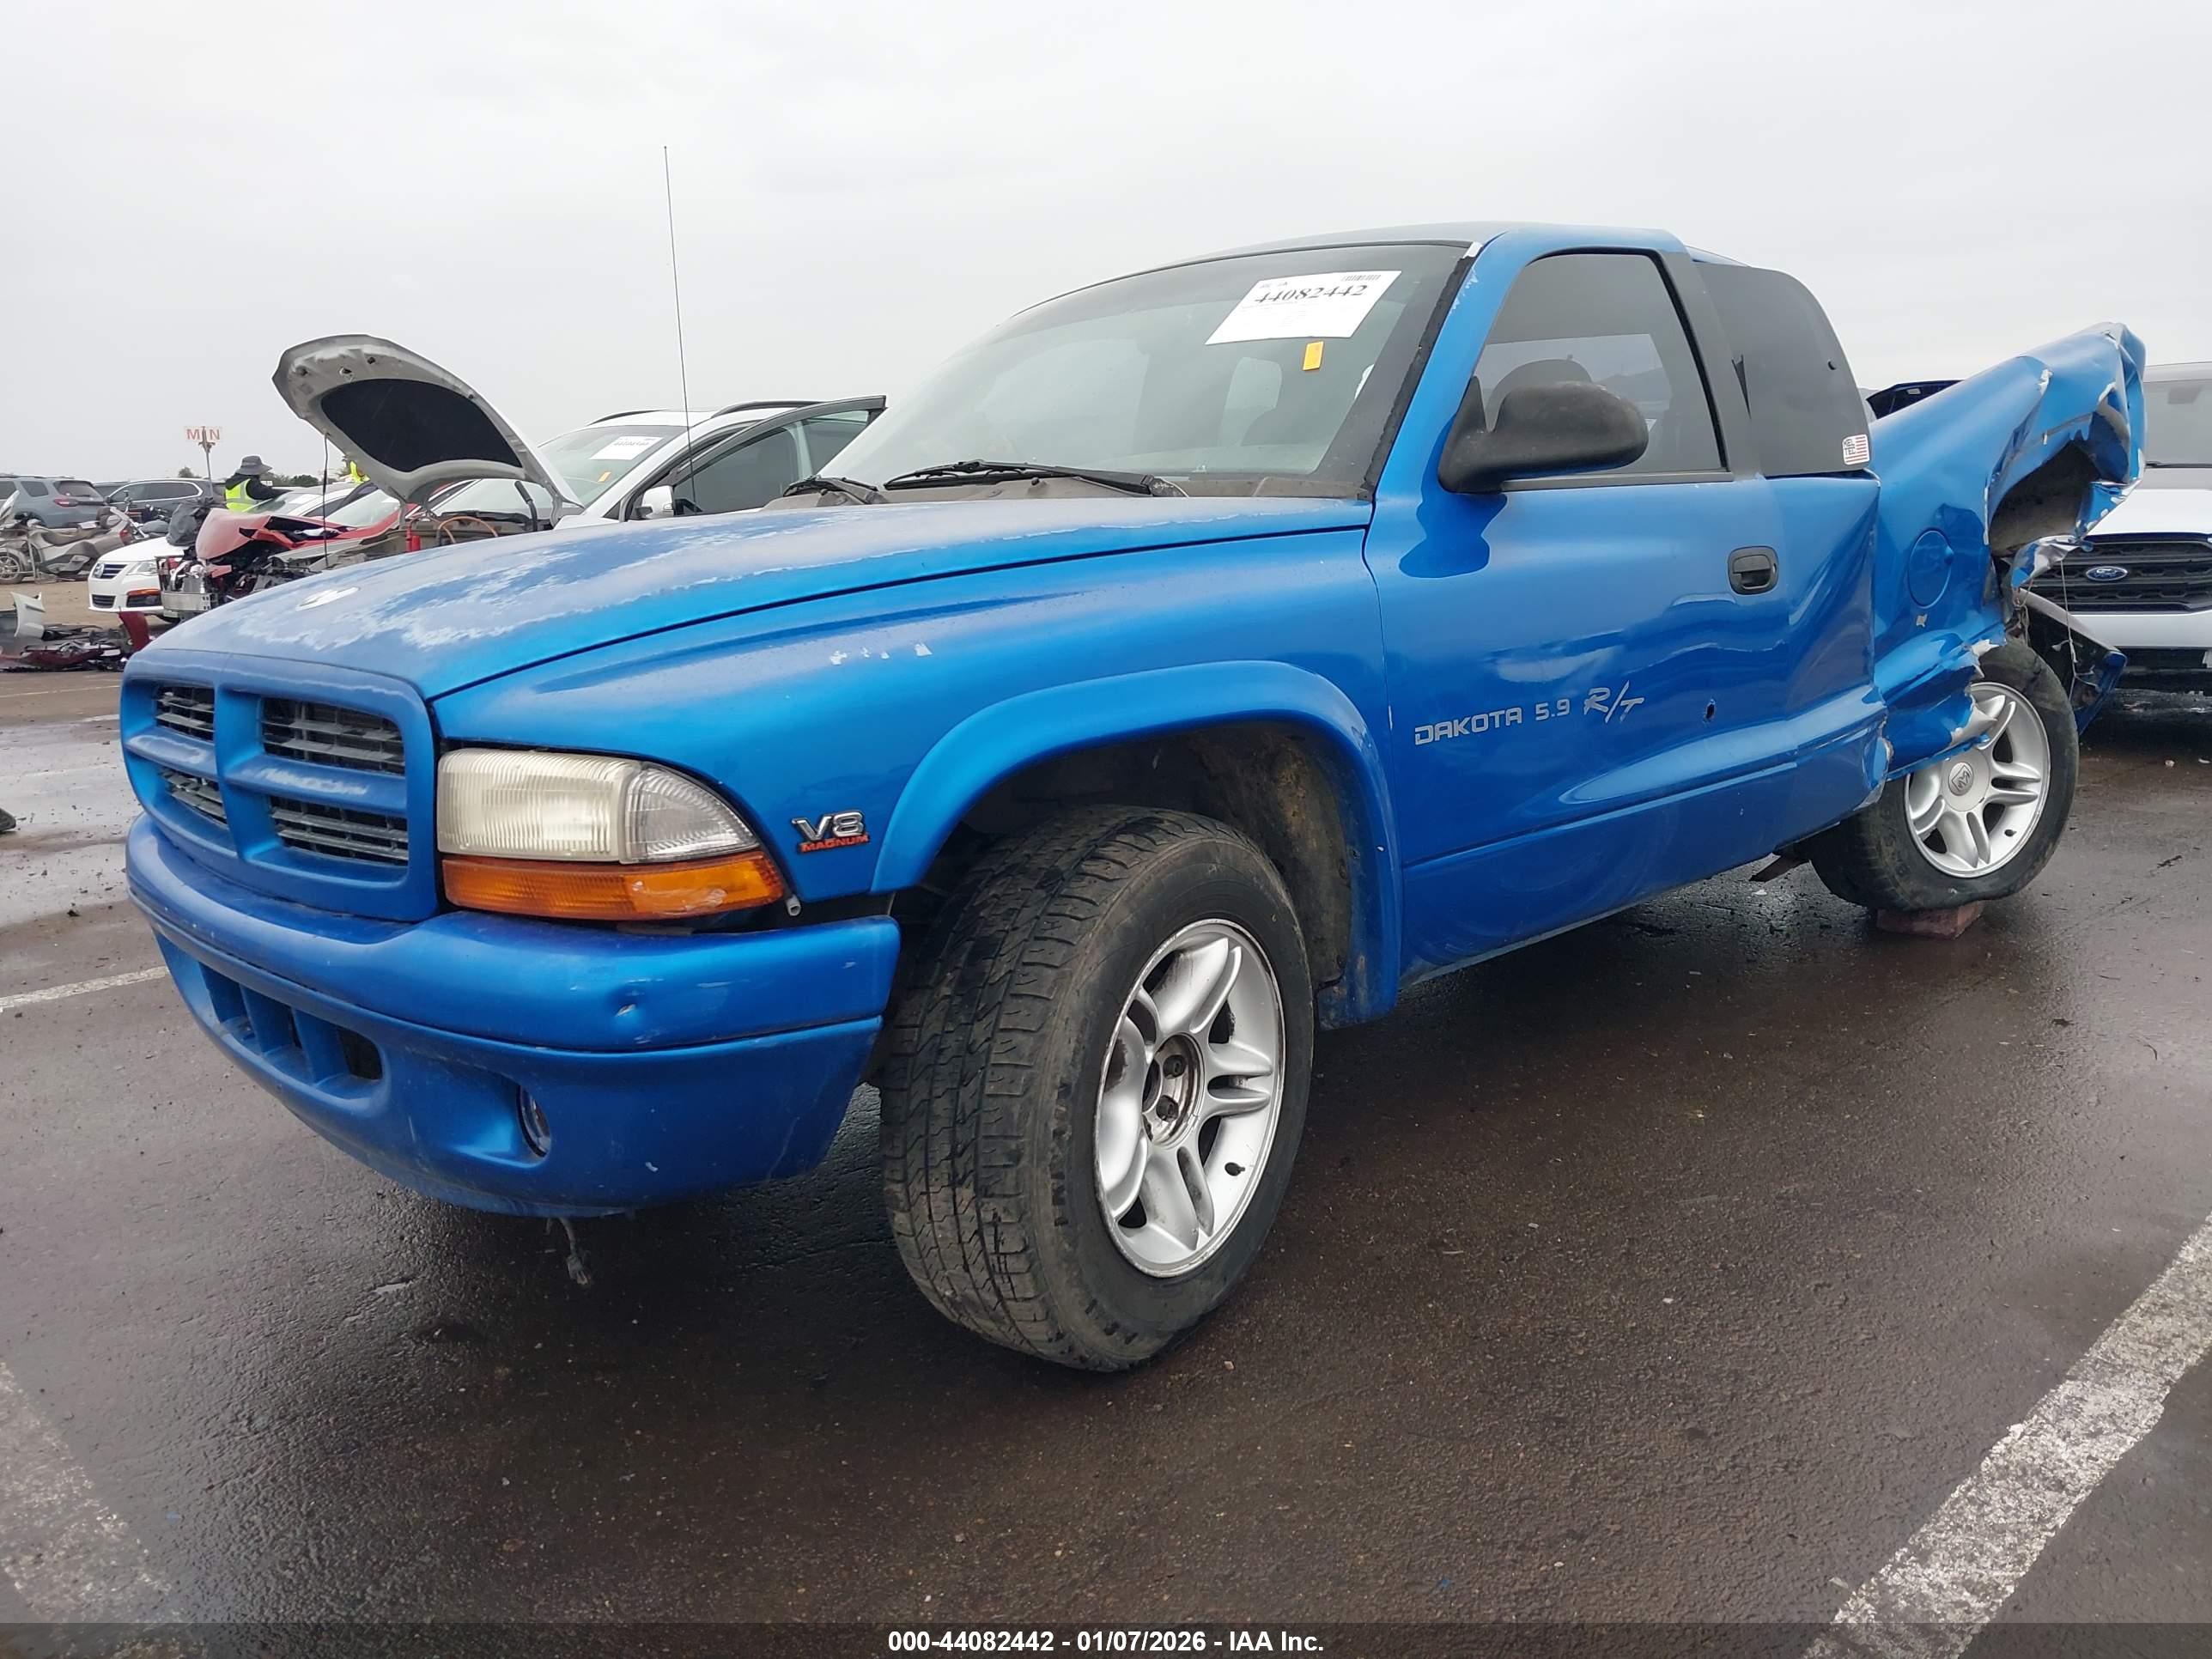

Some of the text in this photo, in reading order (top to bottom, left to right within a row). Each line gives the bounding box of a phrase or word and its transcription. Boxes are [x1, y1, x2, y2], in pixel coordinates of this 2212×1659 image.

[1255, 284, 1368, 304] 44082442
[1414, 680, 1645, 745] DAKOTA 5.9 R/T
[791, 810, 865, 842] V8
[799, 833, 870, 853] MAGNUM
